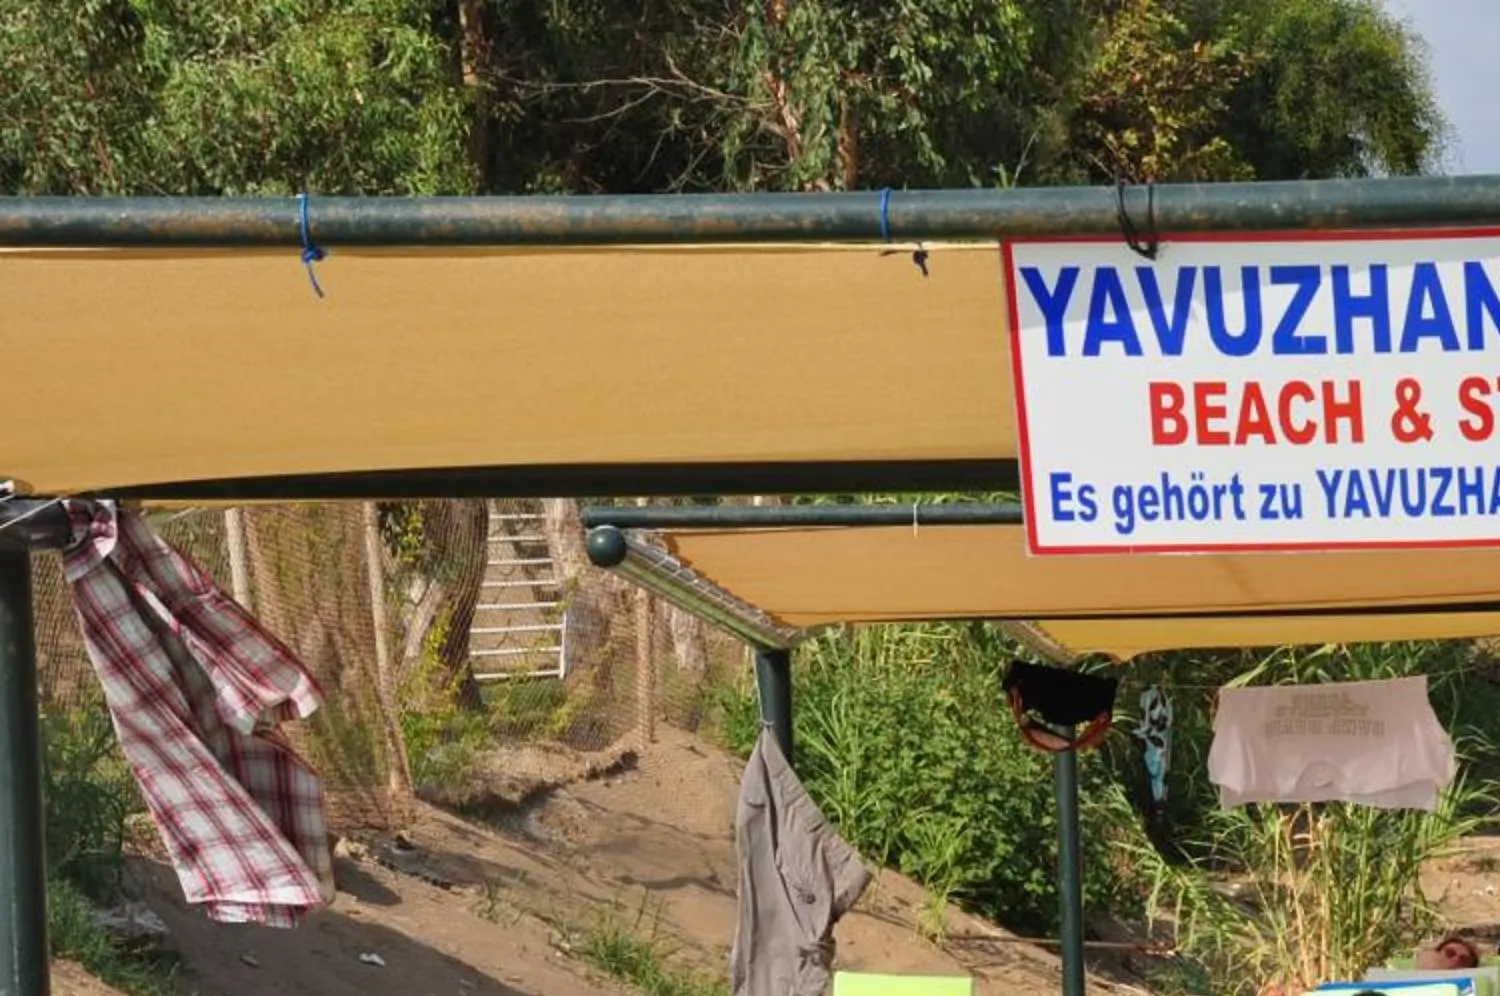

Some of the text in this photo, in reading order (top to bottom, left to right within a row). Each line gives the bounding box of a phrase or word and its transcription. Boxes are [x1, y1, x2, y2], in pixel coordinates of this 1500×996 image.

[1148, 379, 1366, 447] BEACH
[1390, 376, 1434, 445] &
[1049, 470, 1098, 524] Es
[1113, 471, 1245, 536] gehört
[1258, 484, 1304, 522] zu
